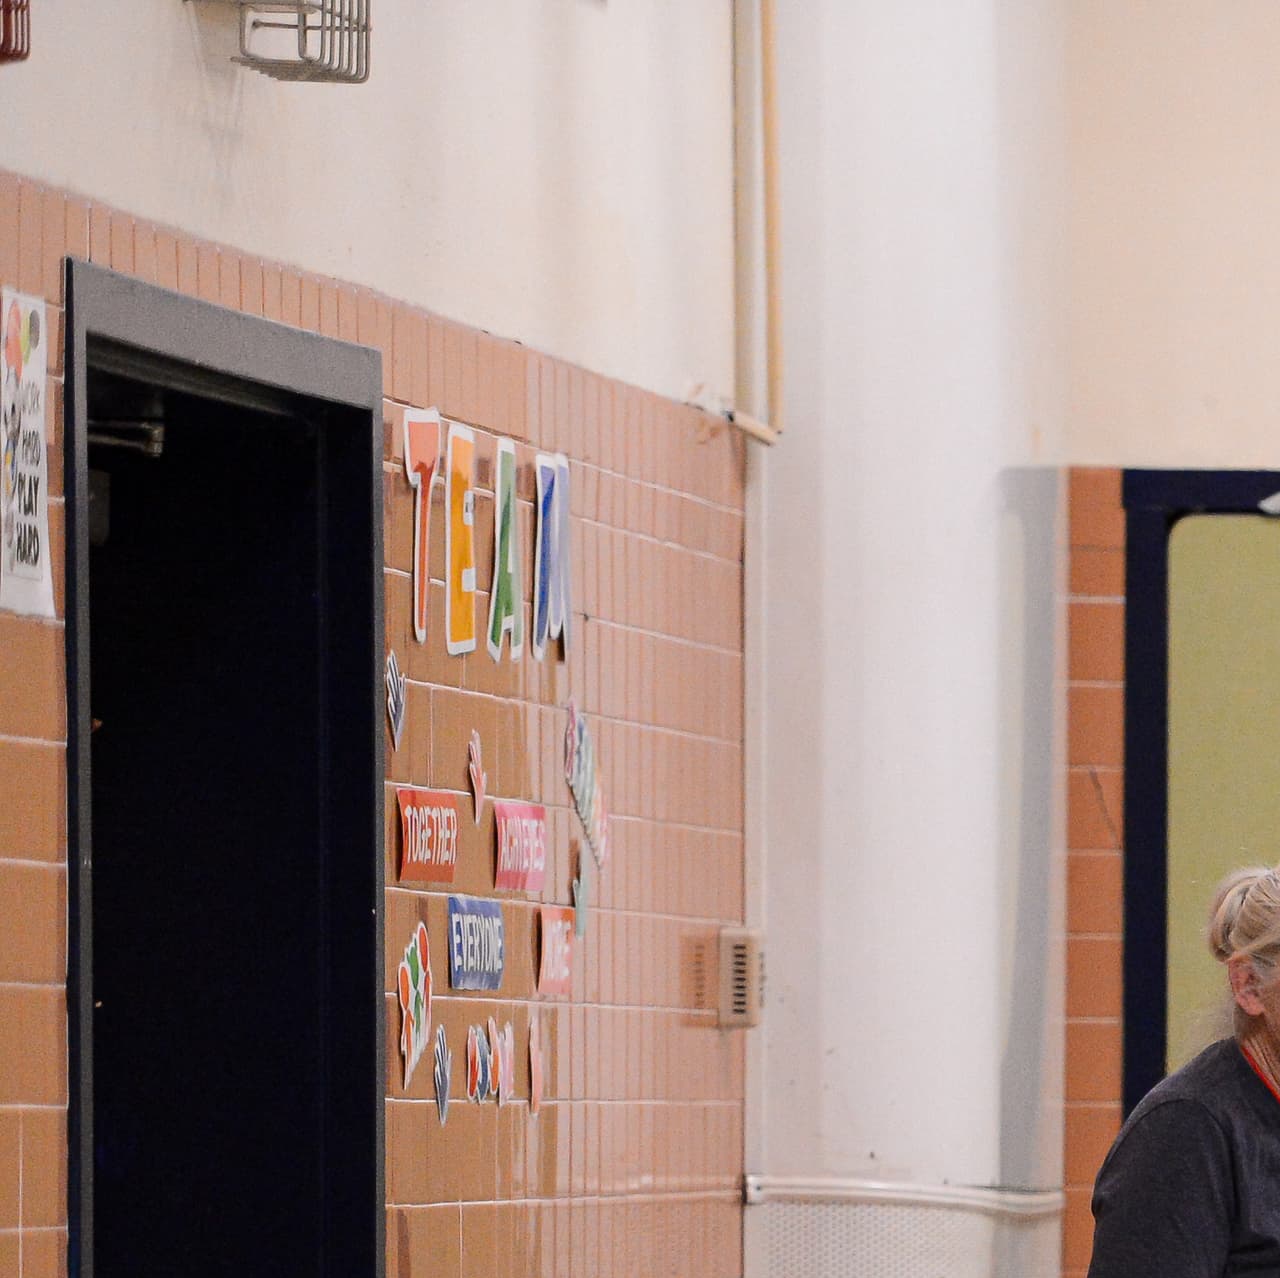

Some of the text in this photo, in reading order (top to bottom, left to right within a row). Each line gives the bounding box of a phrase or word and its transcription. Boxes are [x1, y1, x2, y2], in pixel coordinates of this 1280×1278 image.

[17, 471, 40, 517] PLAY
[16, 522, 40, 567] HARD
[403, 407, 571, 663] TEAM
[404, 805, 458, 866] TOGETHER
[451, 912, 504, 973] EVERYONE
